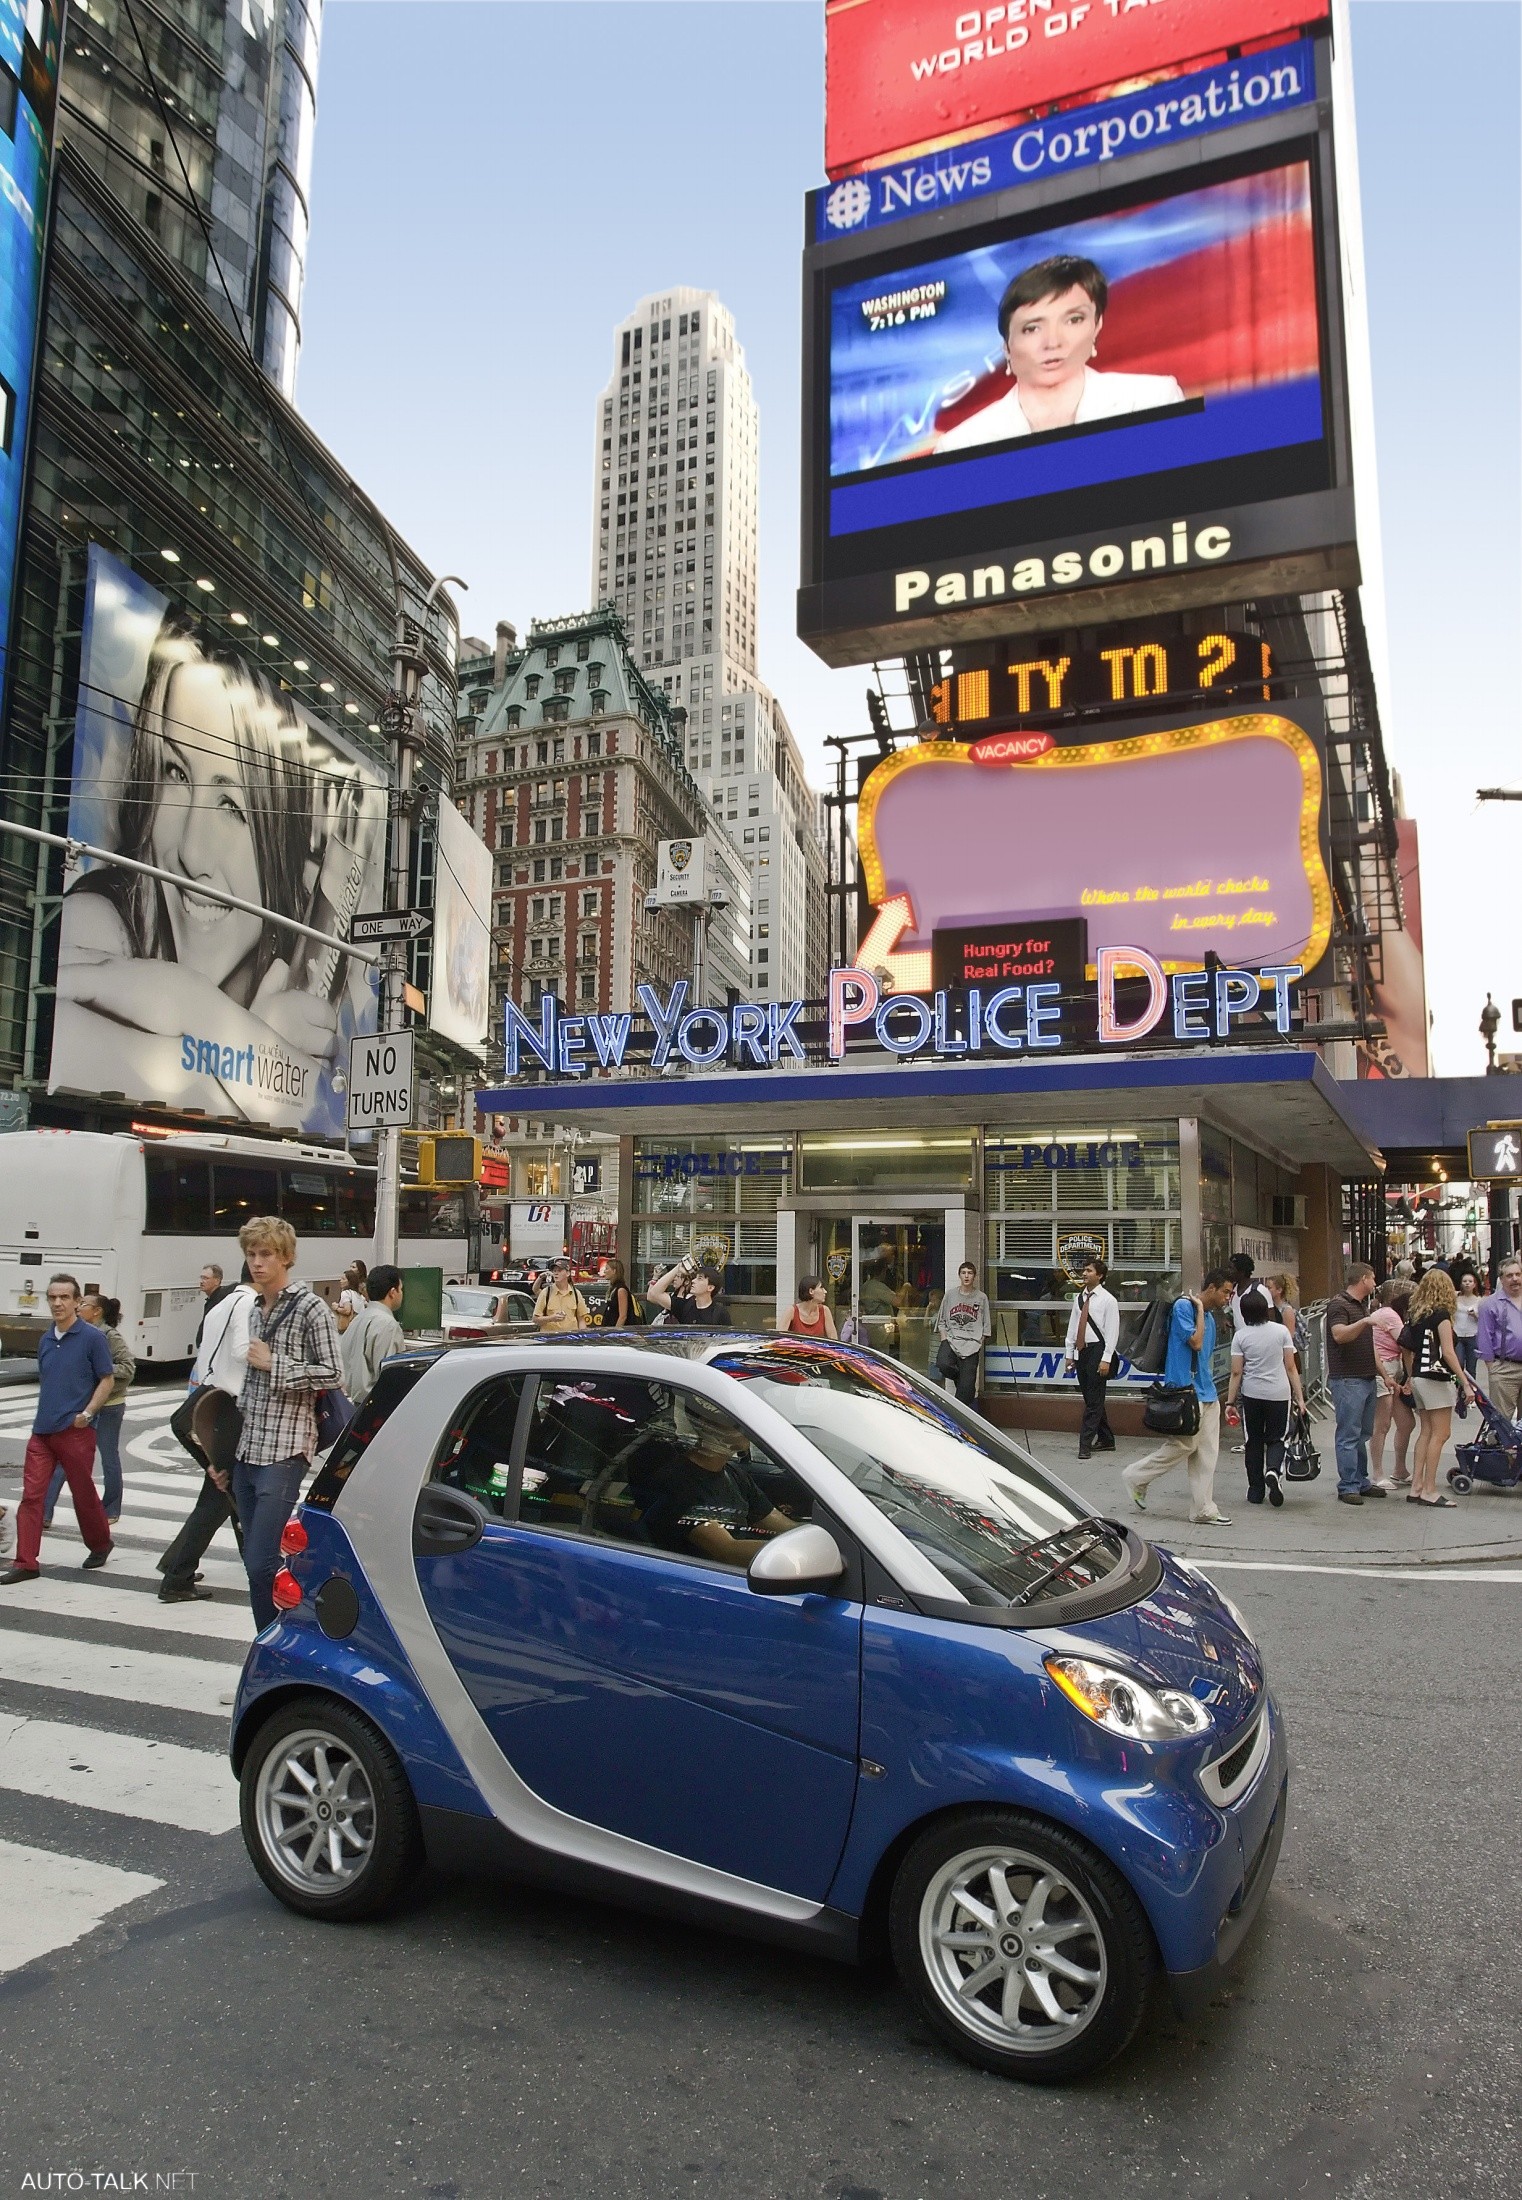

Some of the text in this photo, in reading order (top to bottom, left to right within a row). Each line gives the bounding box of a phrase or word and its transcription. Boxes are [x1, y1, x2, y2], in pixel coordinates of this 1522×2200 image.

[955, 0, 1053, 41] OPEN
[910, 26, 1030, 81] WORLD
[1043, 3, 1091, 38] OF
[881, 61, 1301, 213] News Corporation
[861, 280, 945, 316] WASHINGTON
[870, 302, 936, 332] 7:16 PM
[895, 521, 1232, 612] Panasonic
[1008, 657, 1071, 713] TY
[1101, 643, 1167, 700] TO
[975, 736, 1048, 761] VACANCY
[669, 873, 690, 881] SECURITY
[1080, 876, 1270, 906] Where the world checks
[361, 917, 424, 935] ONE WAY
[1170, 914, 1189, 931] in
[1191, 913, 1237, 930] every
[963, 939, 1052, 959] Hungry for
[963, 963, 999, 979] Real
[504, 945, 1304, 1076] NEW YORK POLICE DEPT
[181, 1034, 309, 1098] smart water
[366, 1046, 396, 1077] NO
[352, 1088, 408, 1116] TURNS
[663, 1151, 761, 1177] POLICE
[1021, 1142, 1141, 1169] POLICE
[1060, 1241, 1103, 1253] DEPARTMENT
[1068, 1235, 1093, 1243] POLICE
